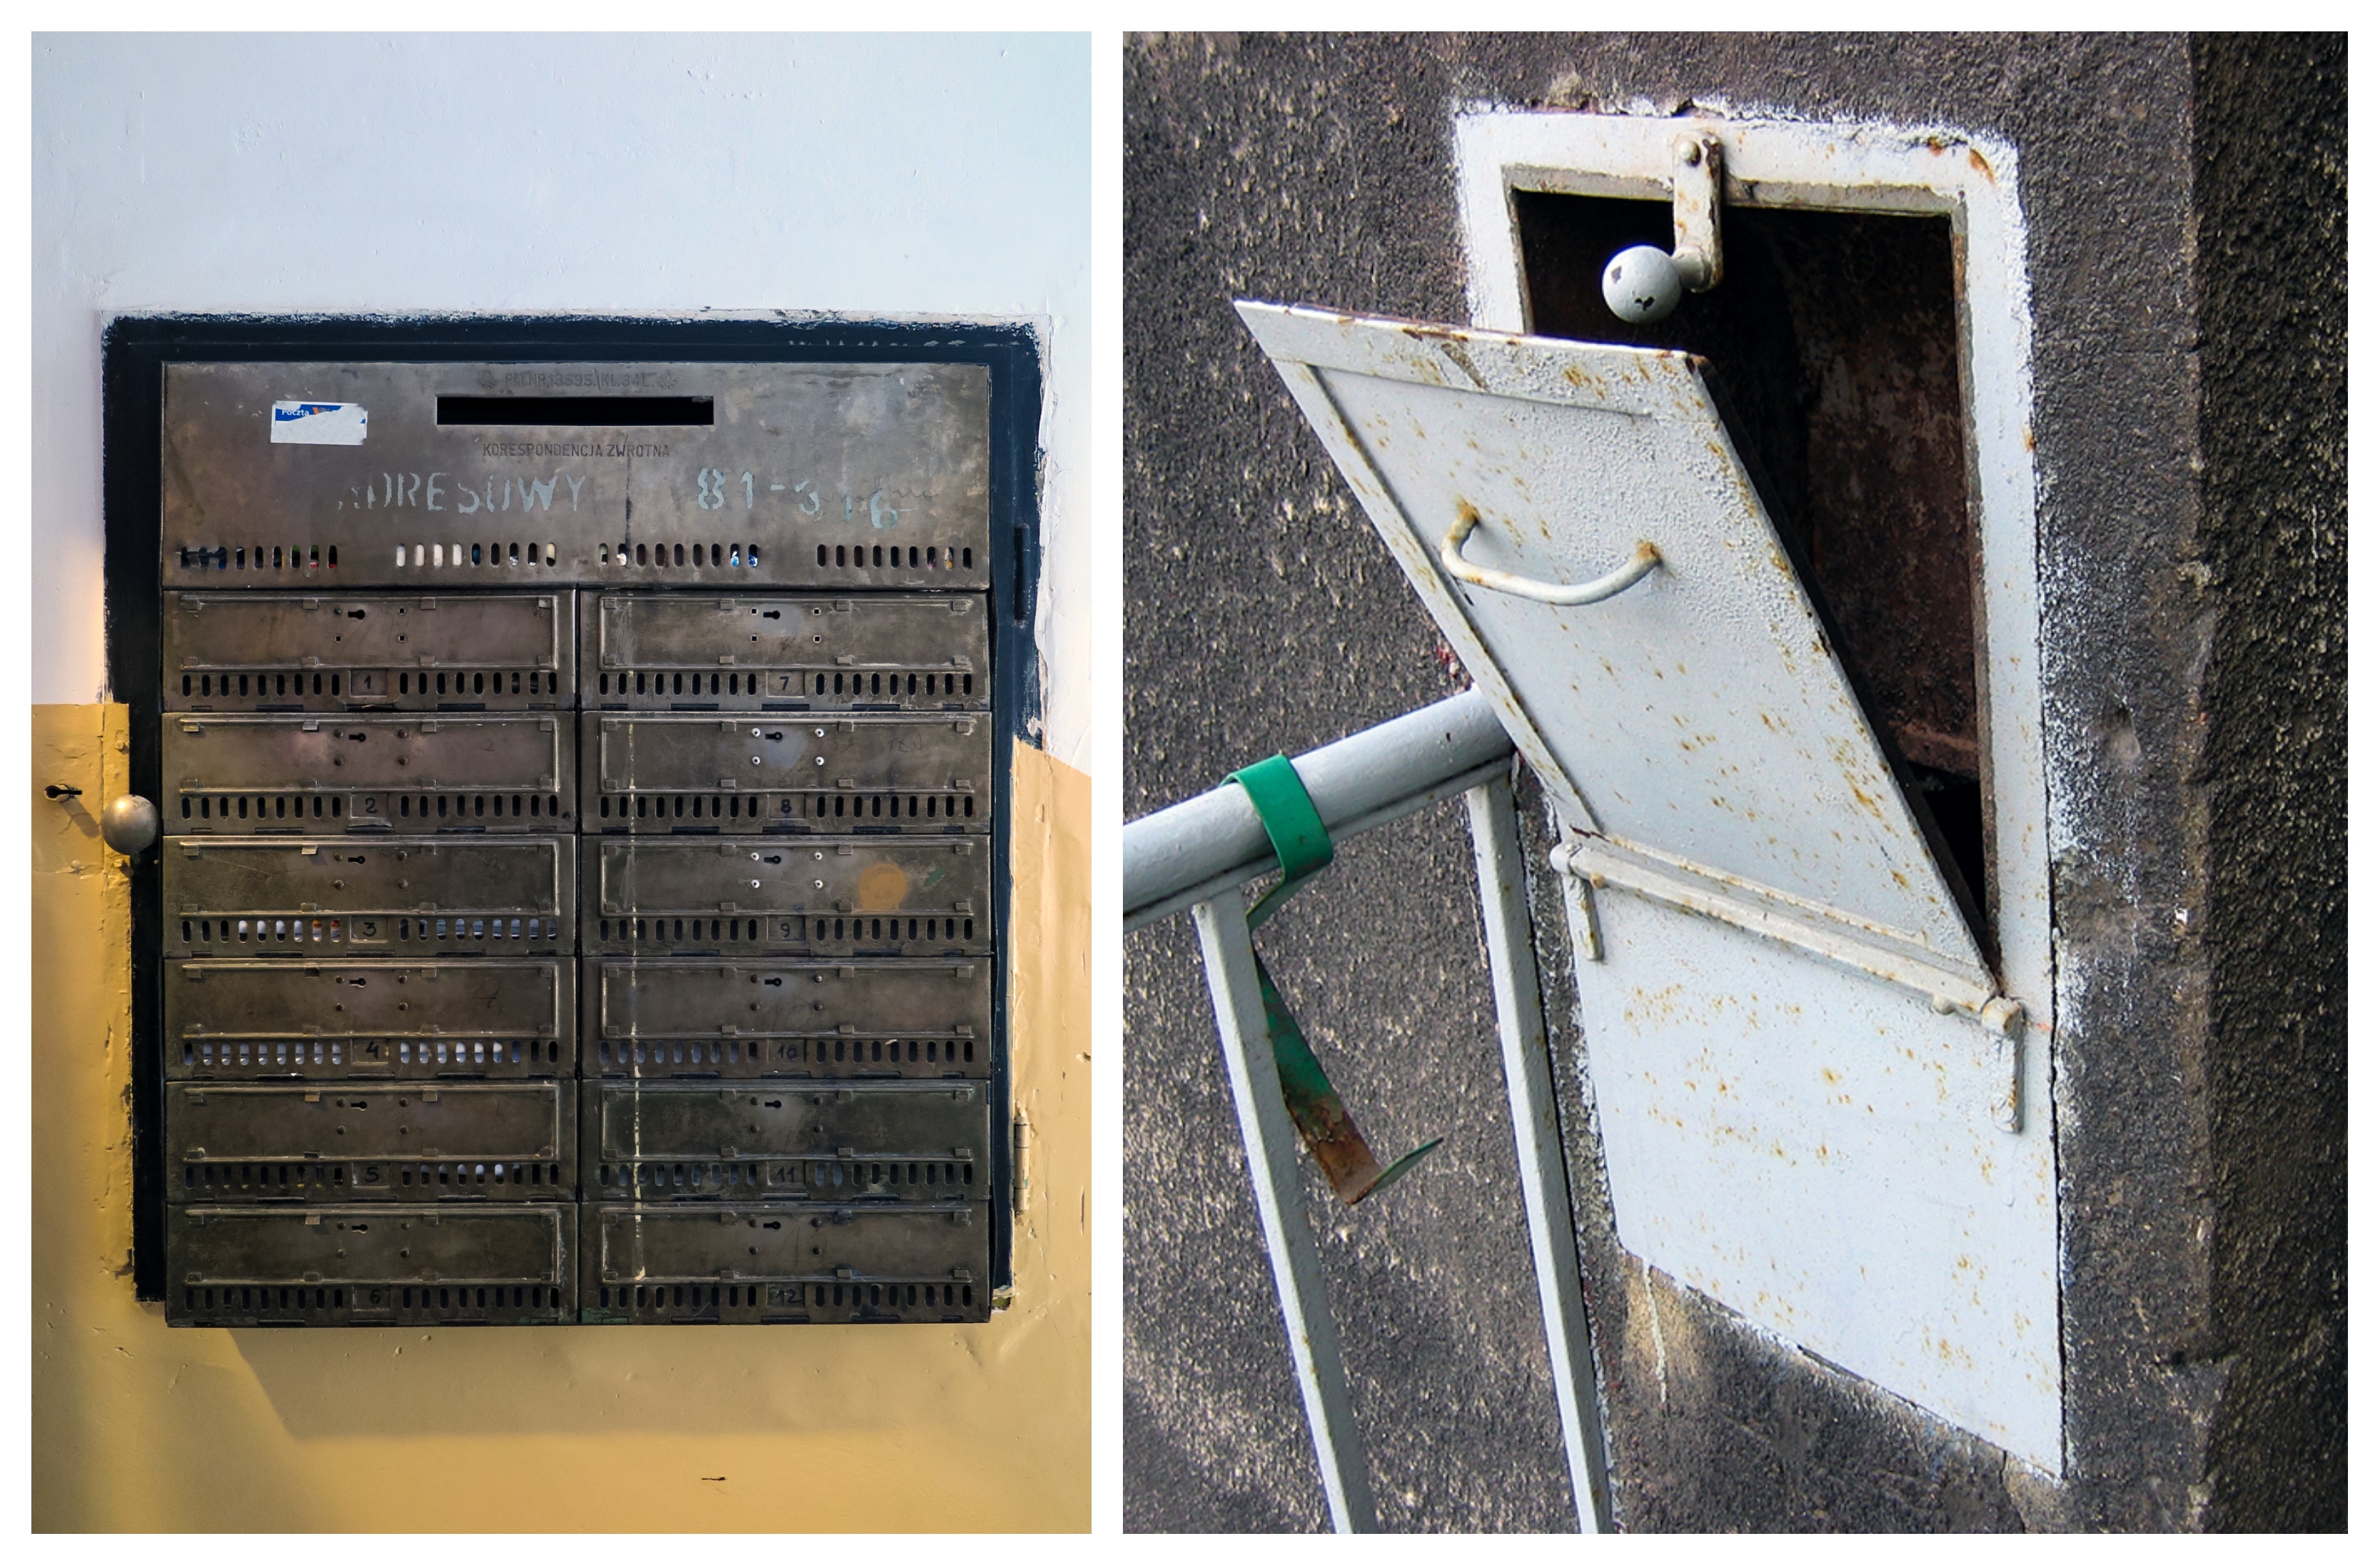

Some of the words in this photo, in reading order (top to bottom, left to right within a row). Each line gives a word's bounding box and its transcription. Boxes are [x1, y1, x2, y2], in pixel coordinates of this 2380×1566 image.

[281, 408, 309, 416] Poczta
[483, 443, 602, 458] KORESPONDENCJA
[607, 443, 669, 458] ZWROTNA
[337, 473, 586, 513] DRESOWY
[363, 675, 372, 689] 1
[779, 675, 790, 691] 7
[365, 796, 378, 814] 2
[780, 799, 793, 815] 8
[362, 922, 377, 937] 3
[779, 923, 790, 938] 9
[365, 1040, 378, 1060] 4
[777, 1045, 798, 1060] 10
[365, 1166, 380, 1183] 5
[777, 1166, 796, 1183] 11
[369, 1289, 381, 1305] 6
[777, 1289, 802, 1307] 12
